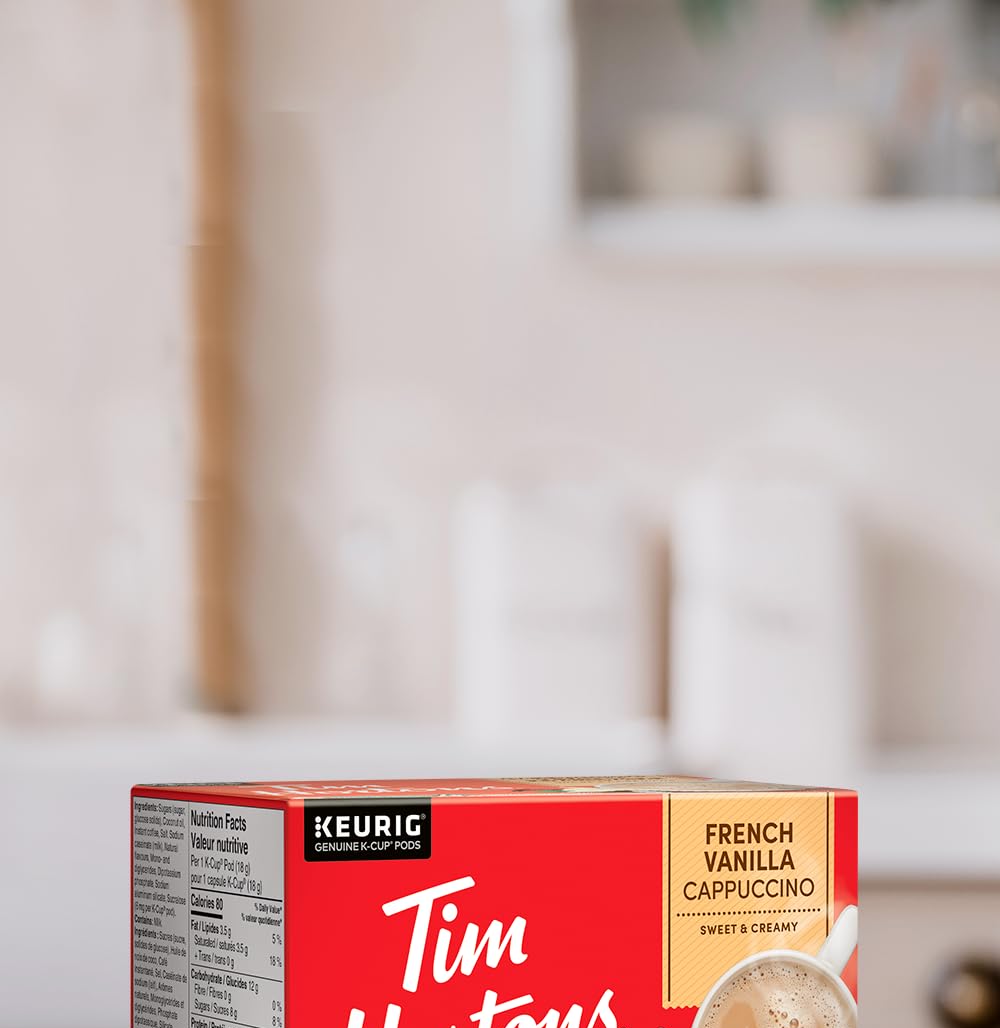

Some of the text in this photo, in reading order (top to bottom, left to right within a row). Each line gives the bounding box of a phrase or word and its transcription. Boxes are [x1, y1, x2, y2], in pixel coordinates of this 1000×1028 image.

[191, 809, 247, 832] Nutrition Facts
[705, 822, 794, 845] FRENCH
[191, 832, 248, 855] Valeur nutritive
[315, 842, 359, 852] GENUINE
[394, 840, 421, 850] PODS
[191, 854, 199, 867] Per
[224, 859, 235, 872] Pod
[704, 849, 795, 872] VANILLA
[191, 874, 201, 885] pour
[207, 875, 227, 888] capsule
[683, 877, 815, 901] CAPPUCCINO
[191, 893, 224, 911] Calories 80
[202, 921, 219, 935] Lipides
[381, 876, 528, 993] Tim
[700, 921, 799, 935] SWEET & CREAMY
[194, 934, 215, 948] Saturated
[271, 933, 276, 944] 5
[198, 949, 211, 963] Trans
[191, 968, 222, 985] Carbohydrate
[226, 975, 247, 990] Glucides
[194, 998, 210, 1013] Sugars
